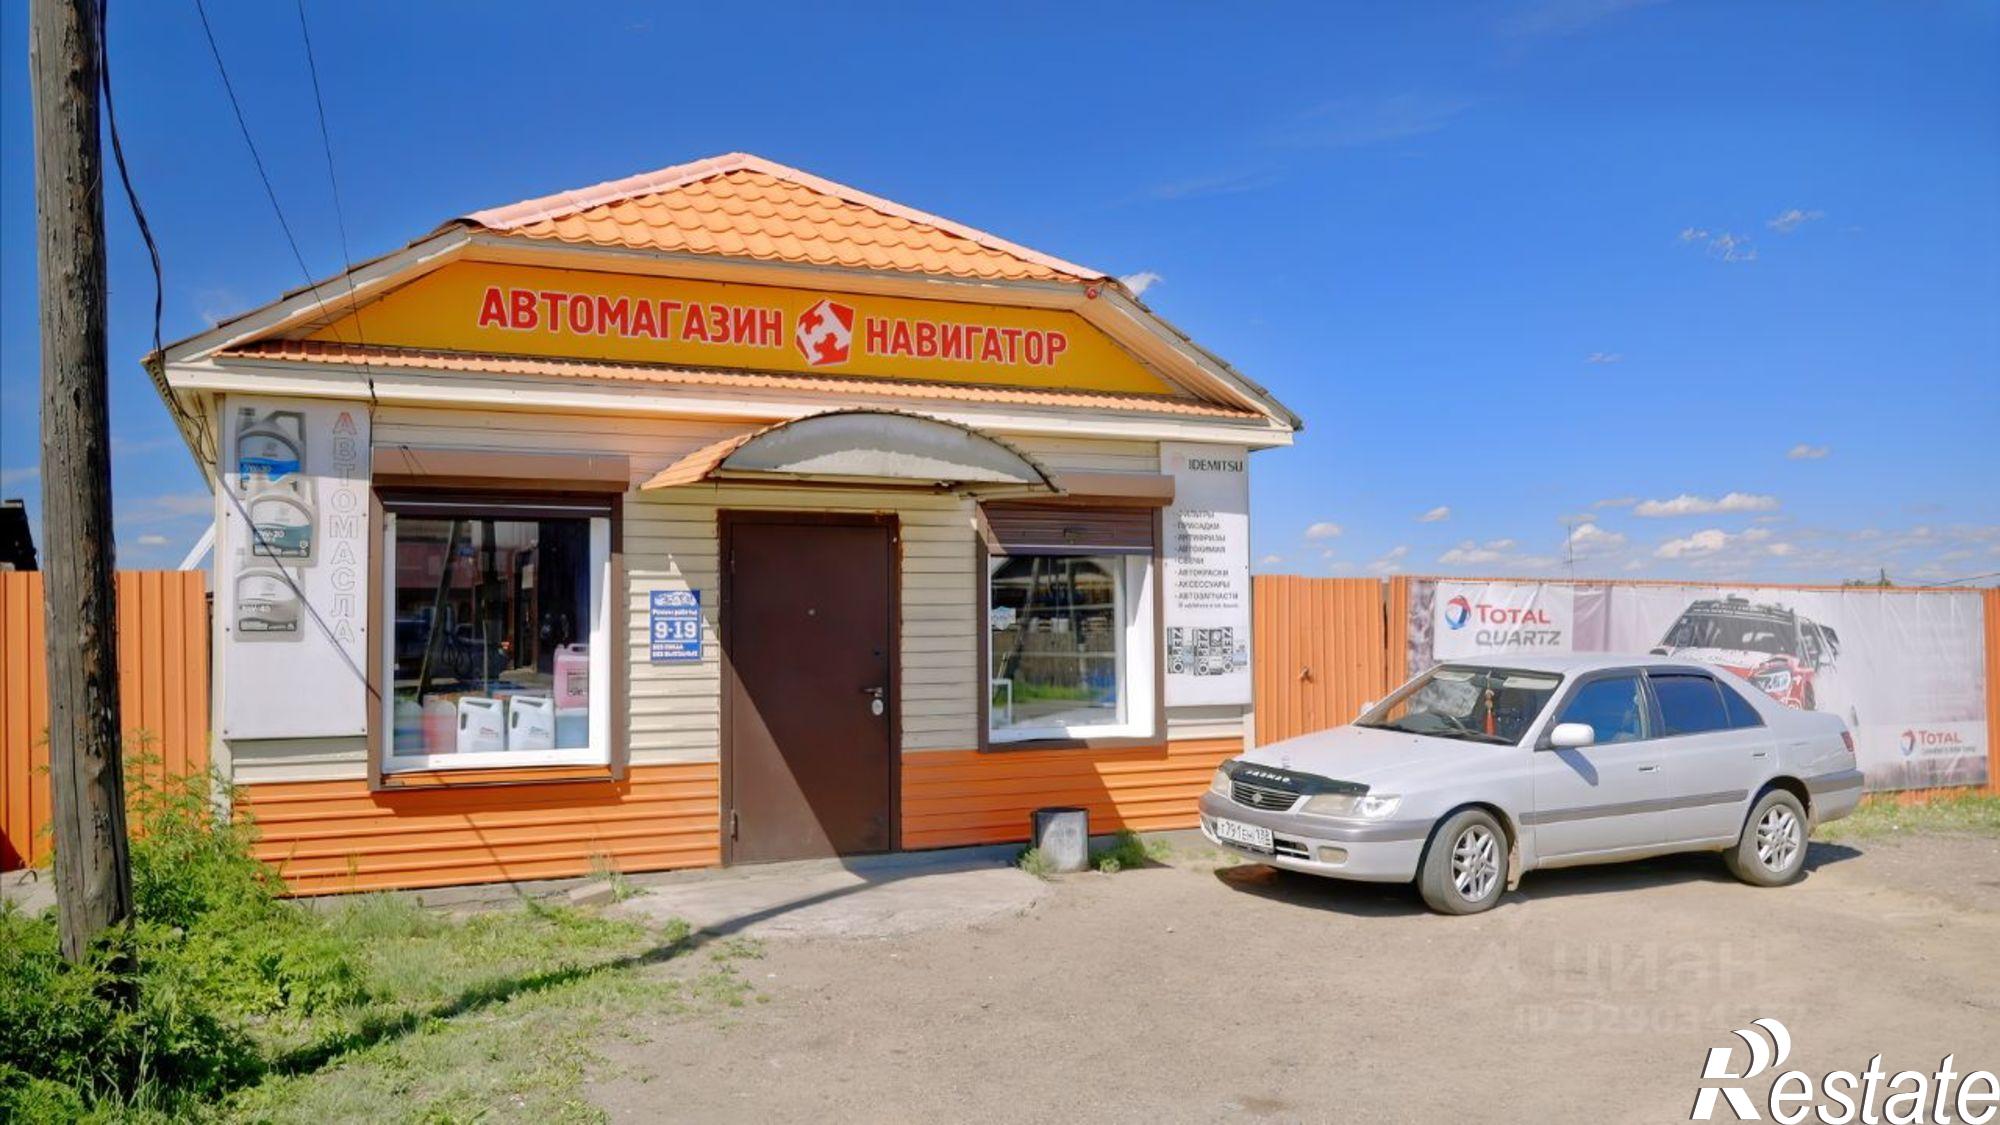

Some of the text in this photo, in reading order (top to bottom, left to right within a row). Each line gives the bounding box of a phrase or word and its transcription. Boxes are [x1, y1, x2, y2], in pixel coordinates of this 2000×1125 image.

[477, 285, 1068, 367] АВТОМАГАЗИН НАВИГАТОР
[1188, 459, 1244, 472] IDEMITSU
[329, 411, 360, 645] АВТОМАСЛА
[1475, 604, 1551, 625] TOTAL
[1475, 629, 1561, 648] QUARTZ
[1918, 730, 1963, 745] TOTAL
